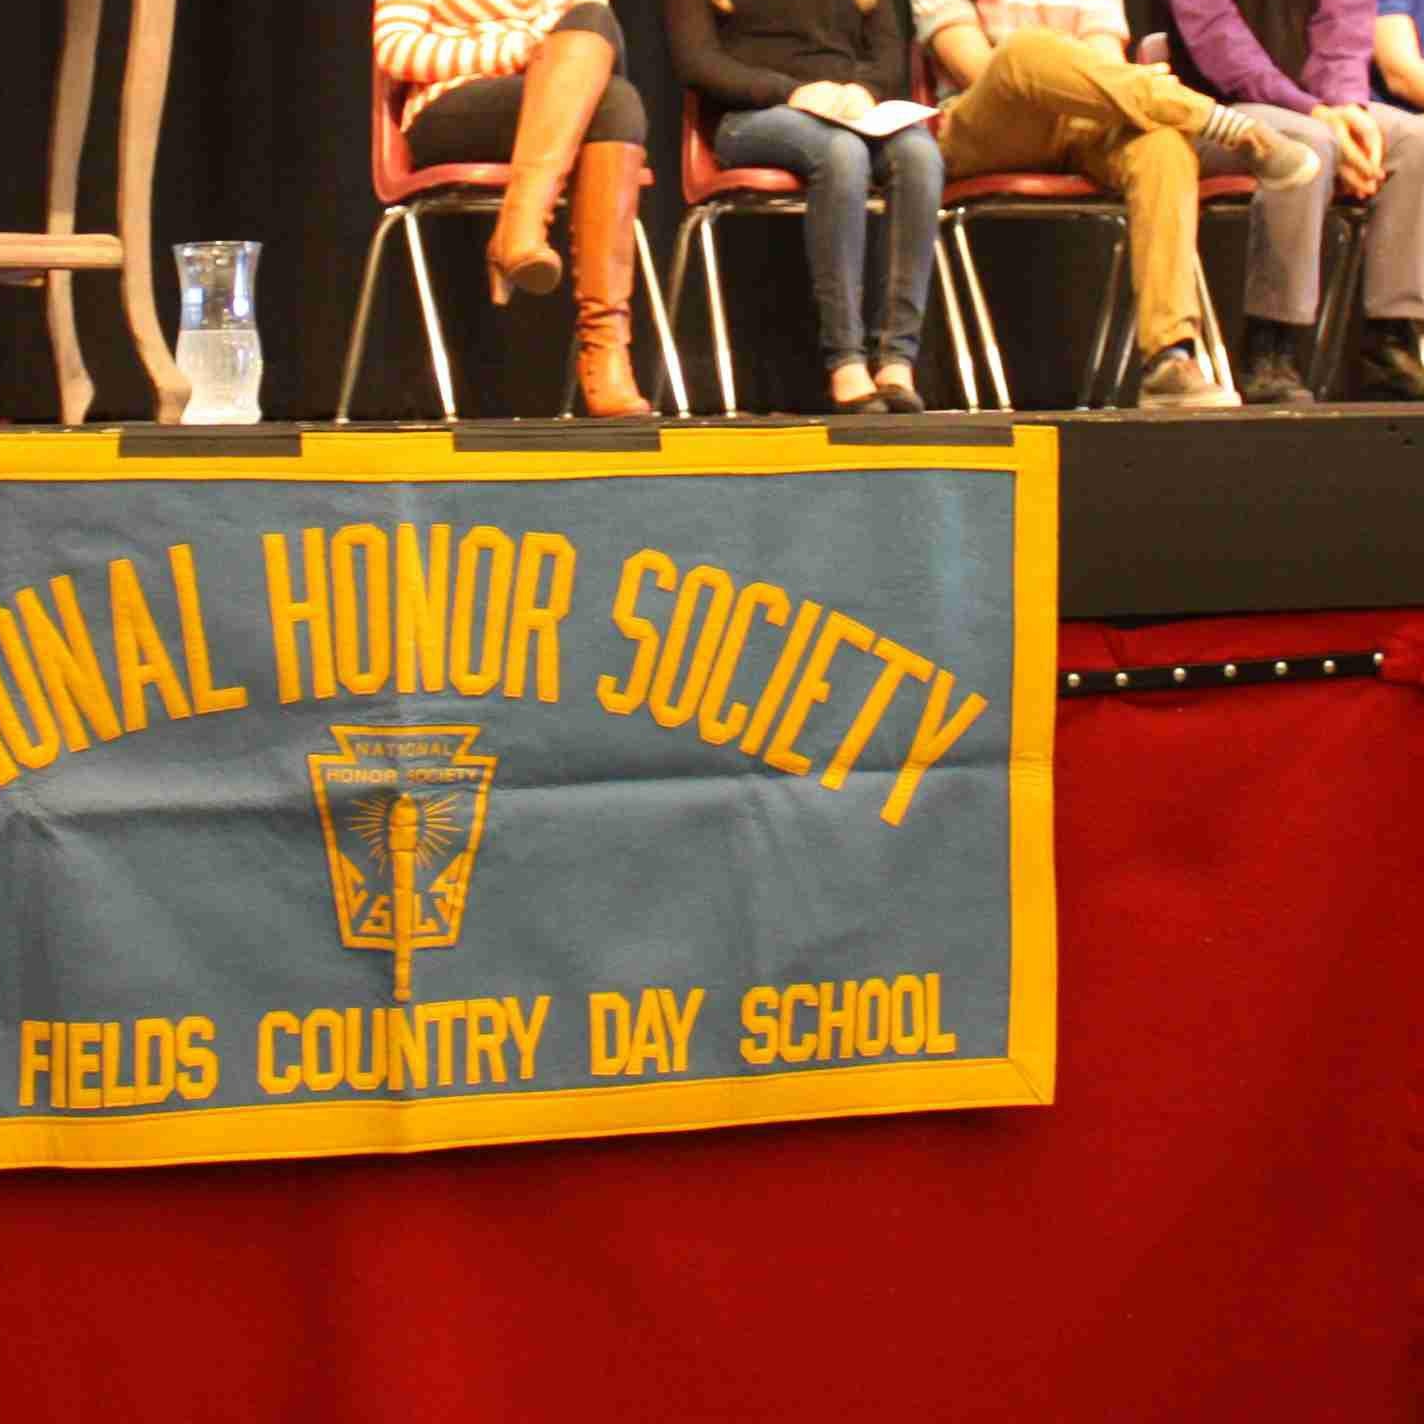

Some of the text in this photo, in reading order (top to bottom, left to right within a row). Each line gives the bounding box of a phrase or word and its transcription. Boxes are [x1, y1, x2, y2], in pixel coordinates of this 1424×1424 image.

[262, 522, 578, 706] HONOR
[597, 548, 989, 827] SOCIETY
[326, 767, 479, 784] HONOR SOCIETY
[353, 741, 453, 757] NATIONAL
[18, 1015, 221, 1110] FIELDS
[256, 994, 552, 1095] COUNTRY
[588, 987, 706, 1077] DAY
[739, 972, 959, 1065] SCHOOL
